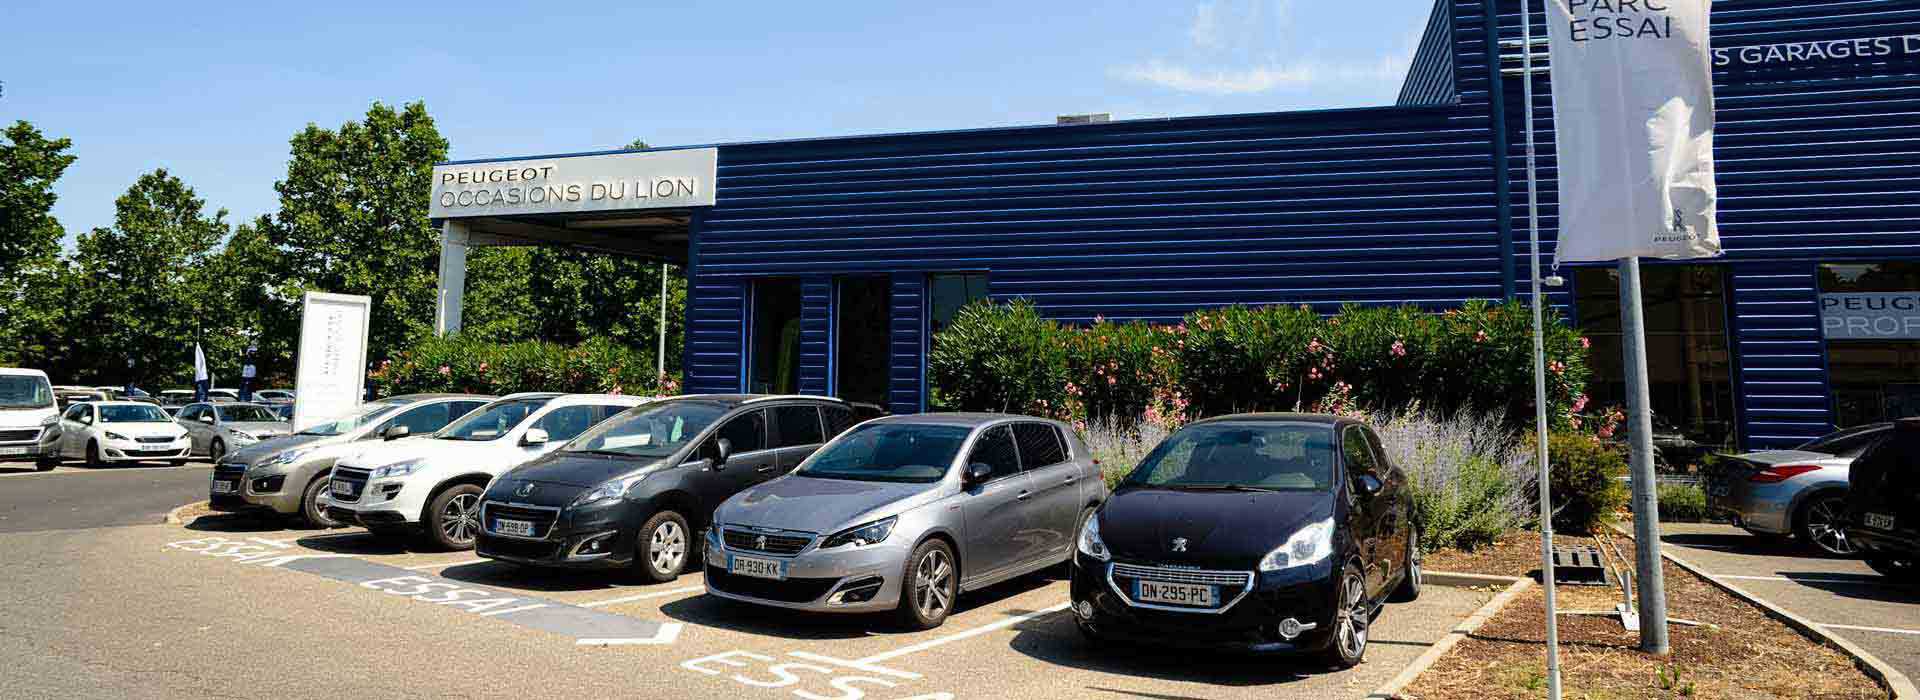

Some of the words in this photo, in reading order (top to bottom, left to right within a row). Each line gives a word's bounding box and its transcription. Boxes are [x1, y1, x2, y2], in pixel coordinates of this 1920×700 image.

[1570, 16, 1671, 42] ESSAI
[1739, 37, 1892, 64] GARAGES
[441, 167, 553, 185] PEUGEOT
[440, 184, 581, 208] OCCASIONS
[591, 182, 625, 201] DU
[635, 178, 696, 199] LION
[1822, 297, 1920, 310] PEUG
[360, 575, 548, 616] ESSAI
[1142, 583, 1208, 604] DN-295-PC
[680, 649, 955, 700] ESS
